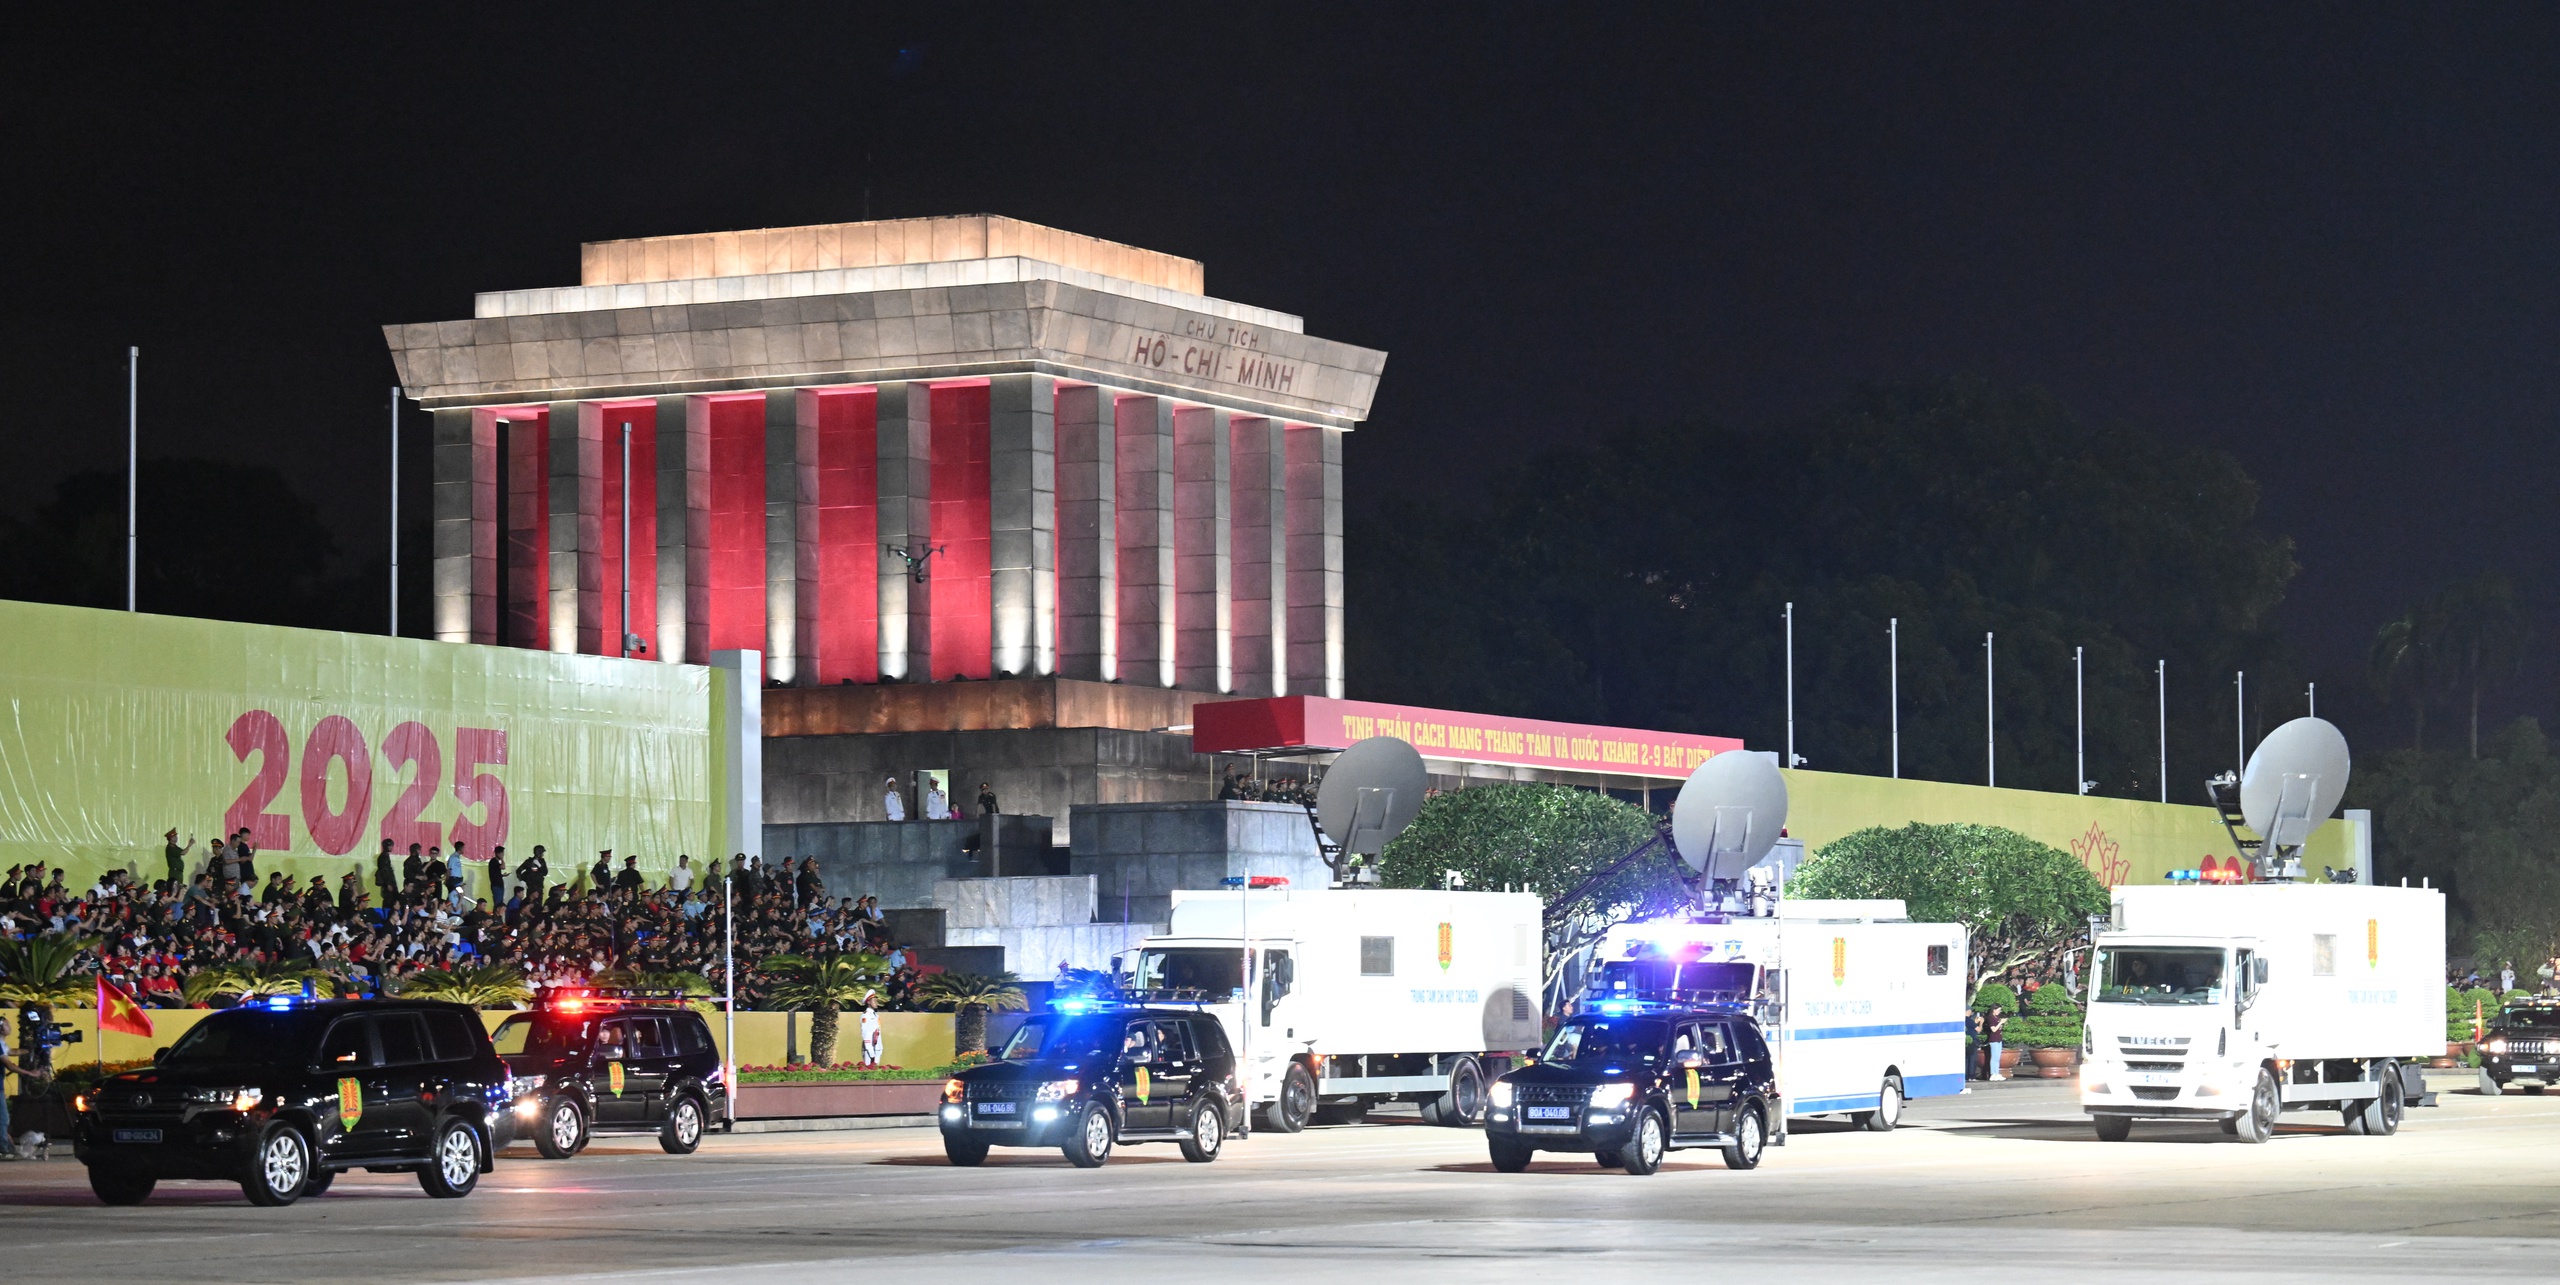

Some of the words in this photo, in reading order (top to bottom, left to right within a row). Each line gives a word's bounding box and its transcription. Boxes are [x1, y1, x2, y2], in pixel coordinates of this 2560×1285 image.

[1342, 715, 1374, 740] TINH
[1414, 718, 1446, 748] CÁCH
[1449, 725, 1482, 755] MẠNG
[1485, 726, 1524, 755] THÁNG
[1526, 729, 1551, 758] TÁM
[1553, 731, 1569, 759] VÀ
[1571, 732, 1599, 762] QUỐC
[1602, 737, 1639, 765] KHÁNH
[1641, 743, 1661, 767] 2-9
[1663, 740, 1684, 768] BẤT
[224, 709, 511, 862] 2025
[2130, 1037, 2176, 1046] IVECO
